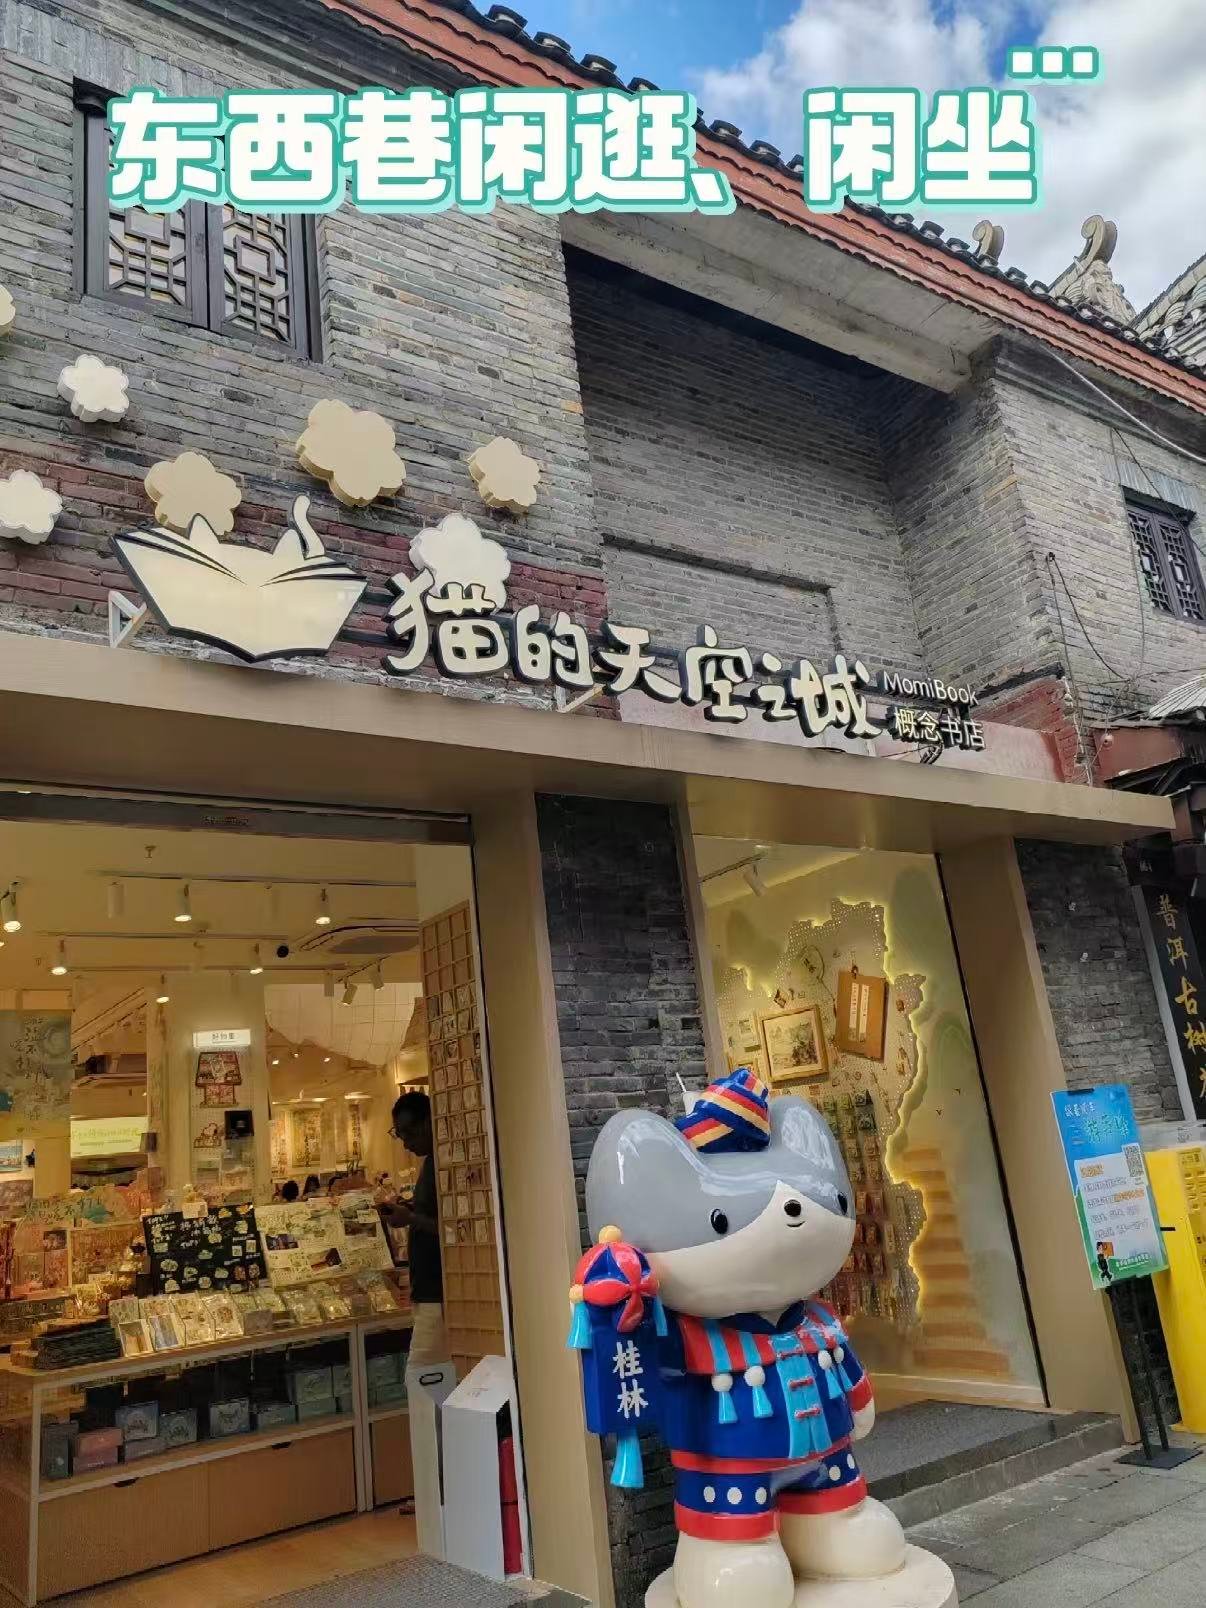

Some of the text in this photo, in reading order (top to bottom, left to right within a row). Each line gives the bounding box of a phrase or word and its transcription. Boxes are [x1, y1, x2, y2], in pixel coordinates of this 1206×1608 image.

[381, 569, 884, 739] 猫的天空之城
[883, 670, 979, 706] MomiBook
[894, 706, 986, 749] 概念书店
[612, 1340, 648, 1418] 桂林
